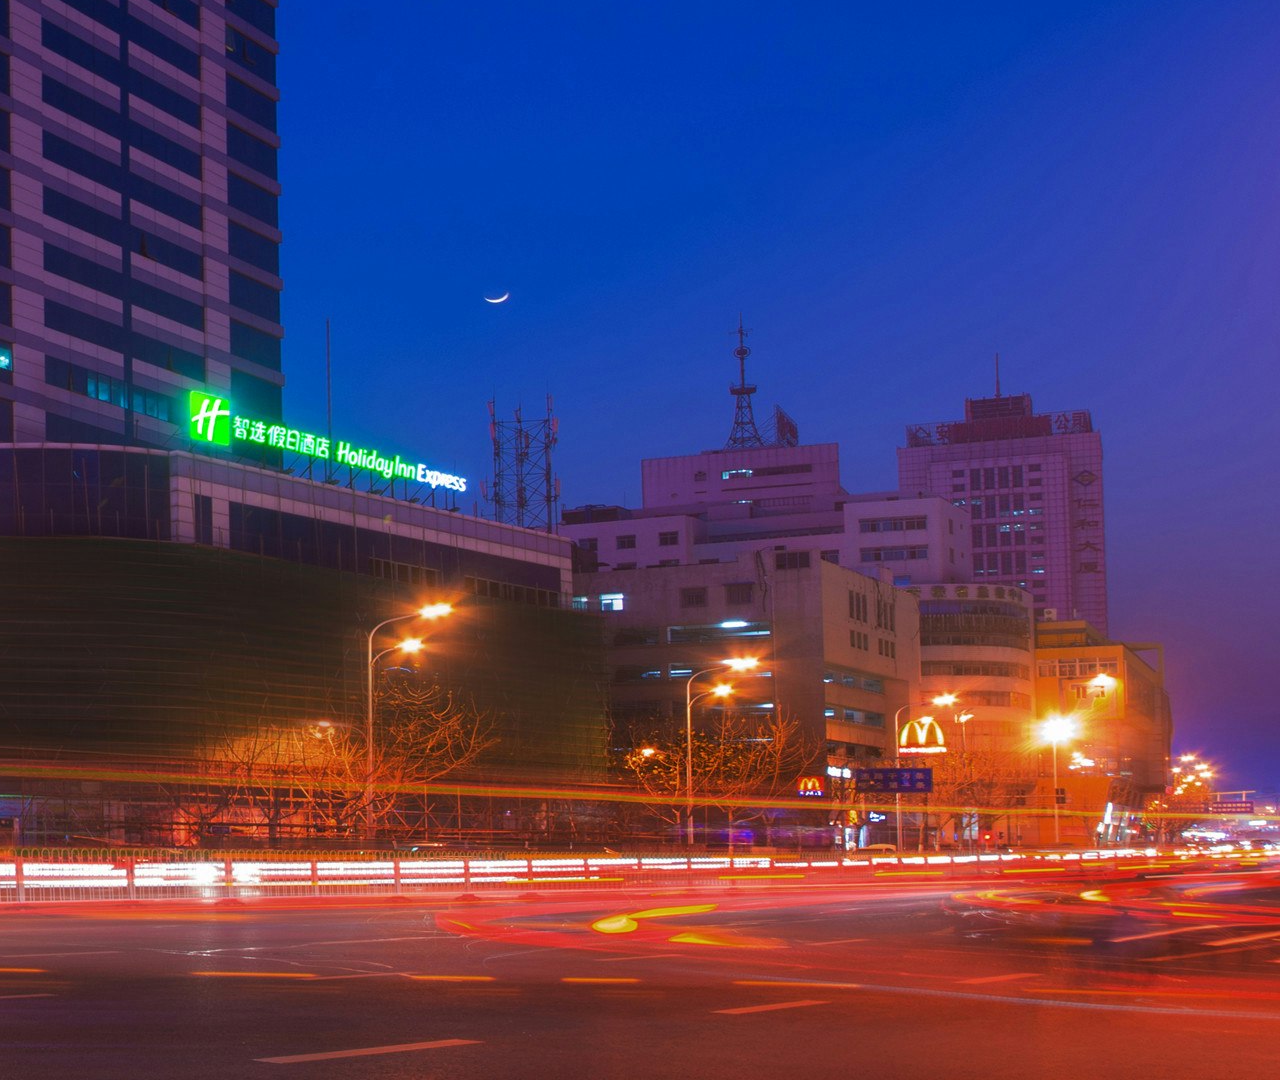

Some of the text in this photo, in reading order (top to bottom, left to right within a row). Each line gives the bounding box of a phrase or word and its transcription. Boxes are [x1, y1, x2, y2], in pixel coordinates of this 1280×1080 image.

[232, 416, 330, 459] 智选假日酒店
[337, 441, 467, 492] Holiday Inn Express
